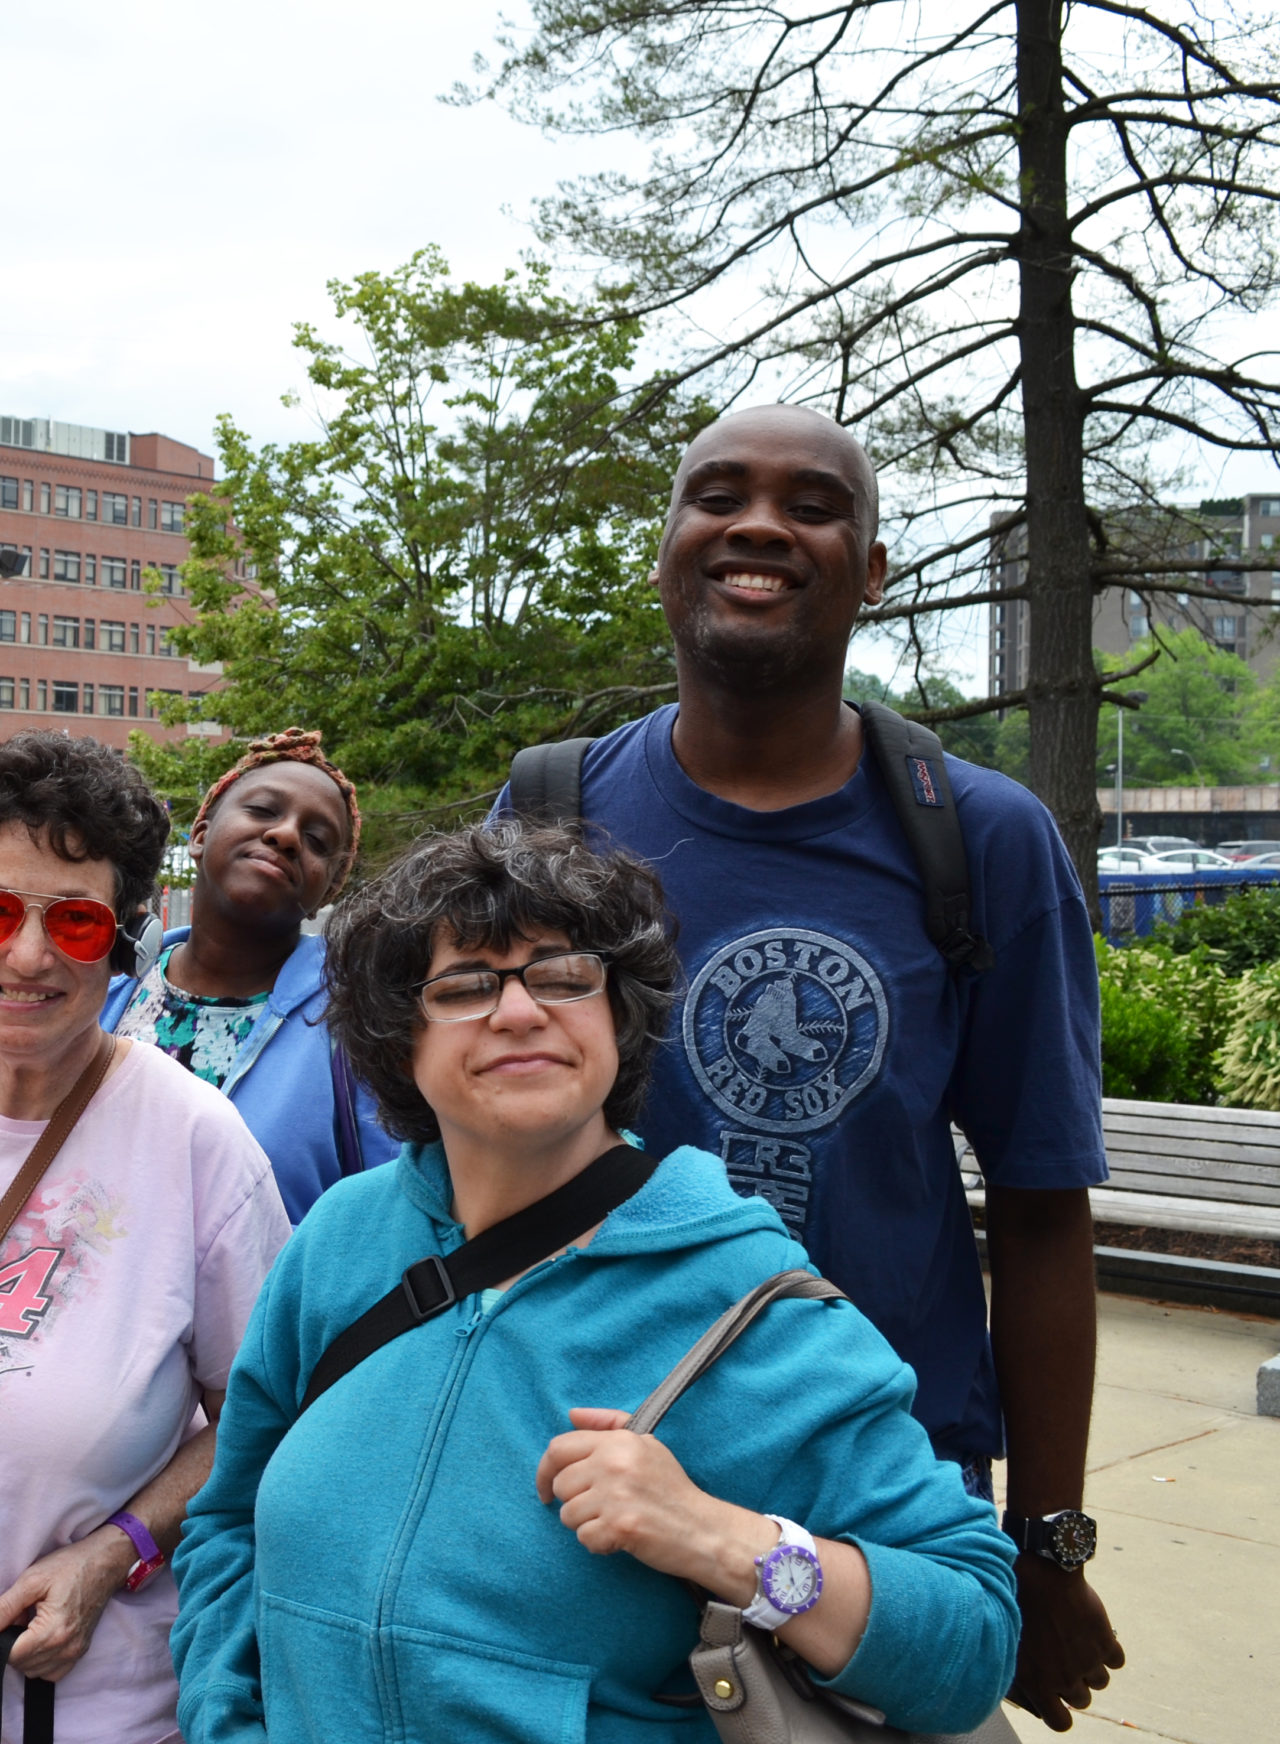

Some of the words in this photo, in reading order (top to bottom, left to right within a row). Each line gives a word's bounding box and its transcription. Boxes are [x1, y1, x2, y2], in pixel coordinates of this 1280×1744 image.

[710, 941, 874, 1012] BOSTON
[705, 1055, 767, 1115] RED
[785, 1068, 845, 1120] SOX
